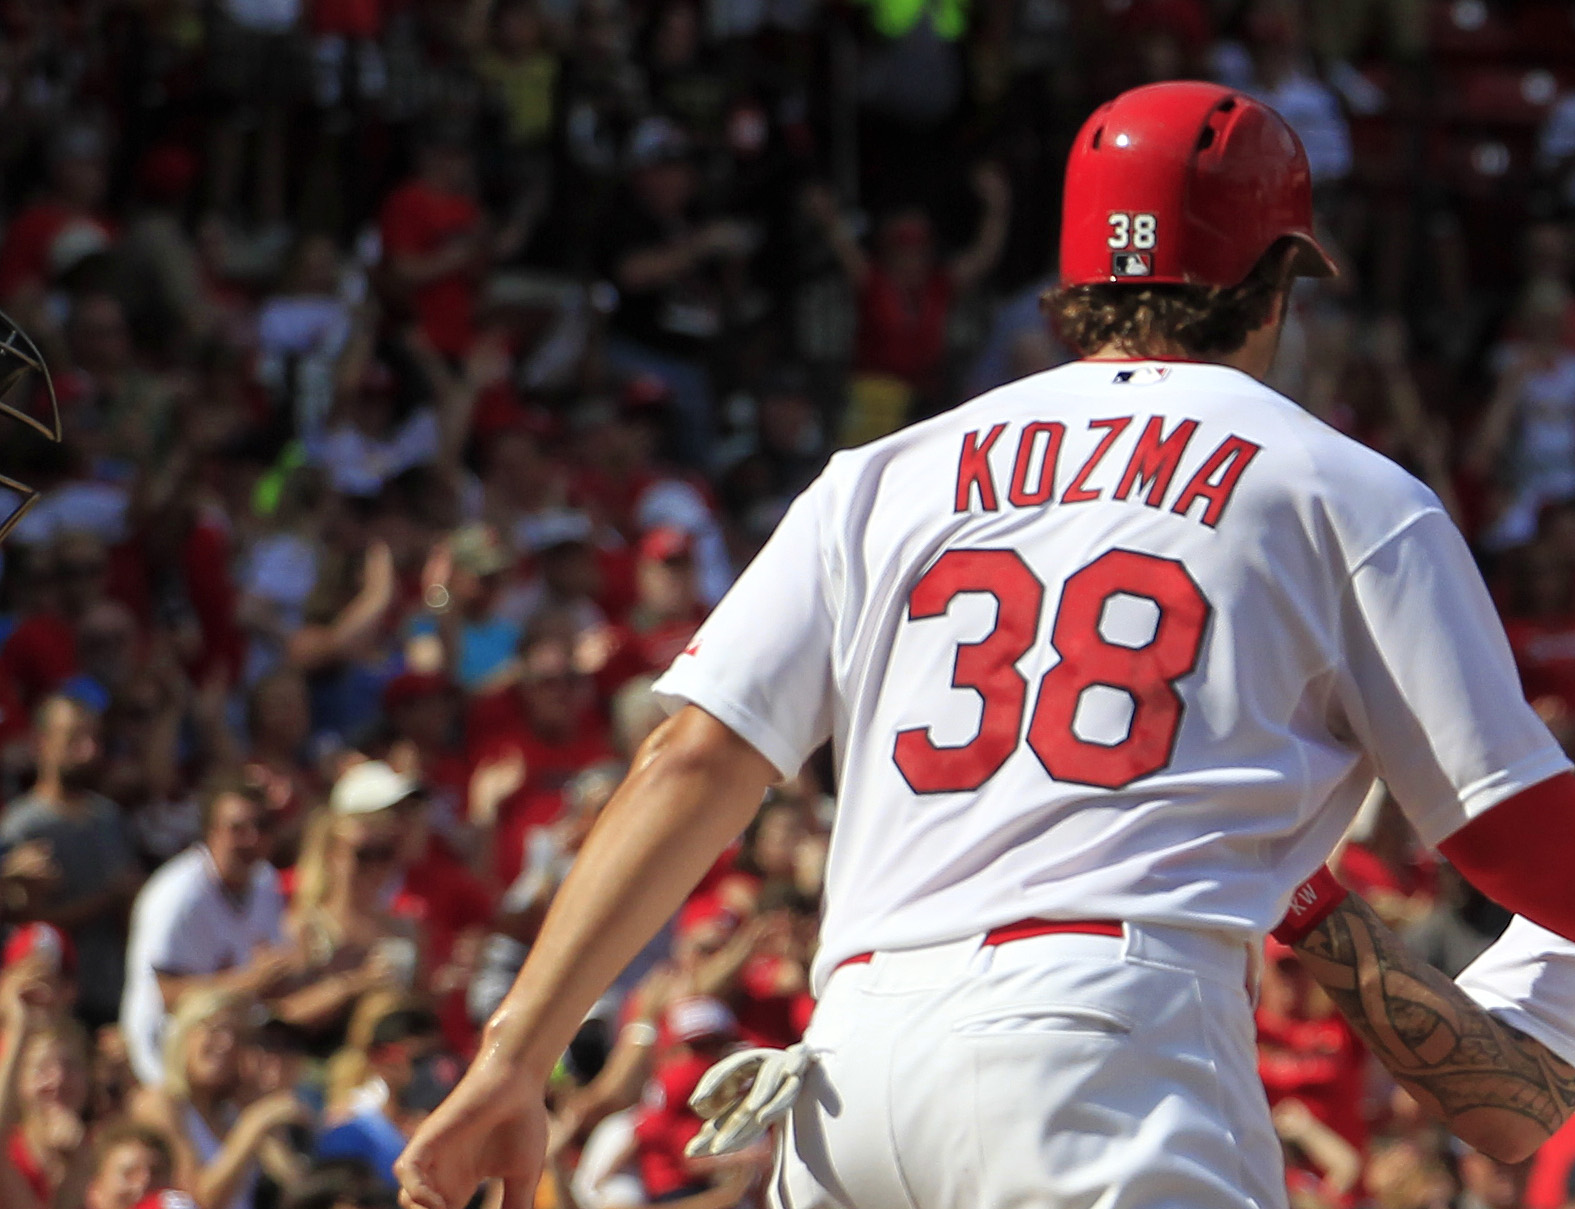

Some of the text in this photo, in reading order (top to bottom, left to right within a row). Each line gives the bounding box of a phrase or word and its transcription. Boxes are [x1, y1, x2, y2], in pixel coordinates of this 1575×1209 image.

[1106, 212, 1157, 250] 38
[953, 415, 1265, 529] KOZMA
[892, 547, 1213, 796] 38
[1289, 882, 1318, 916] KW
